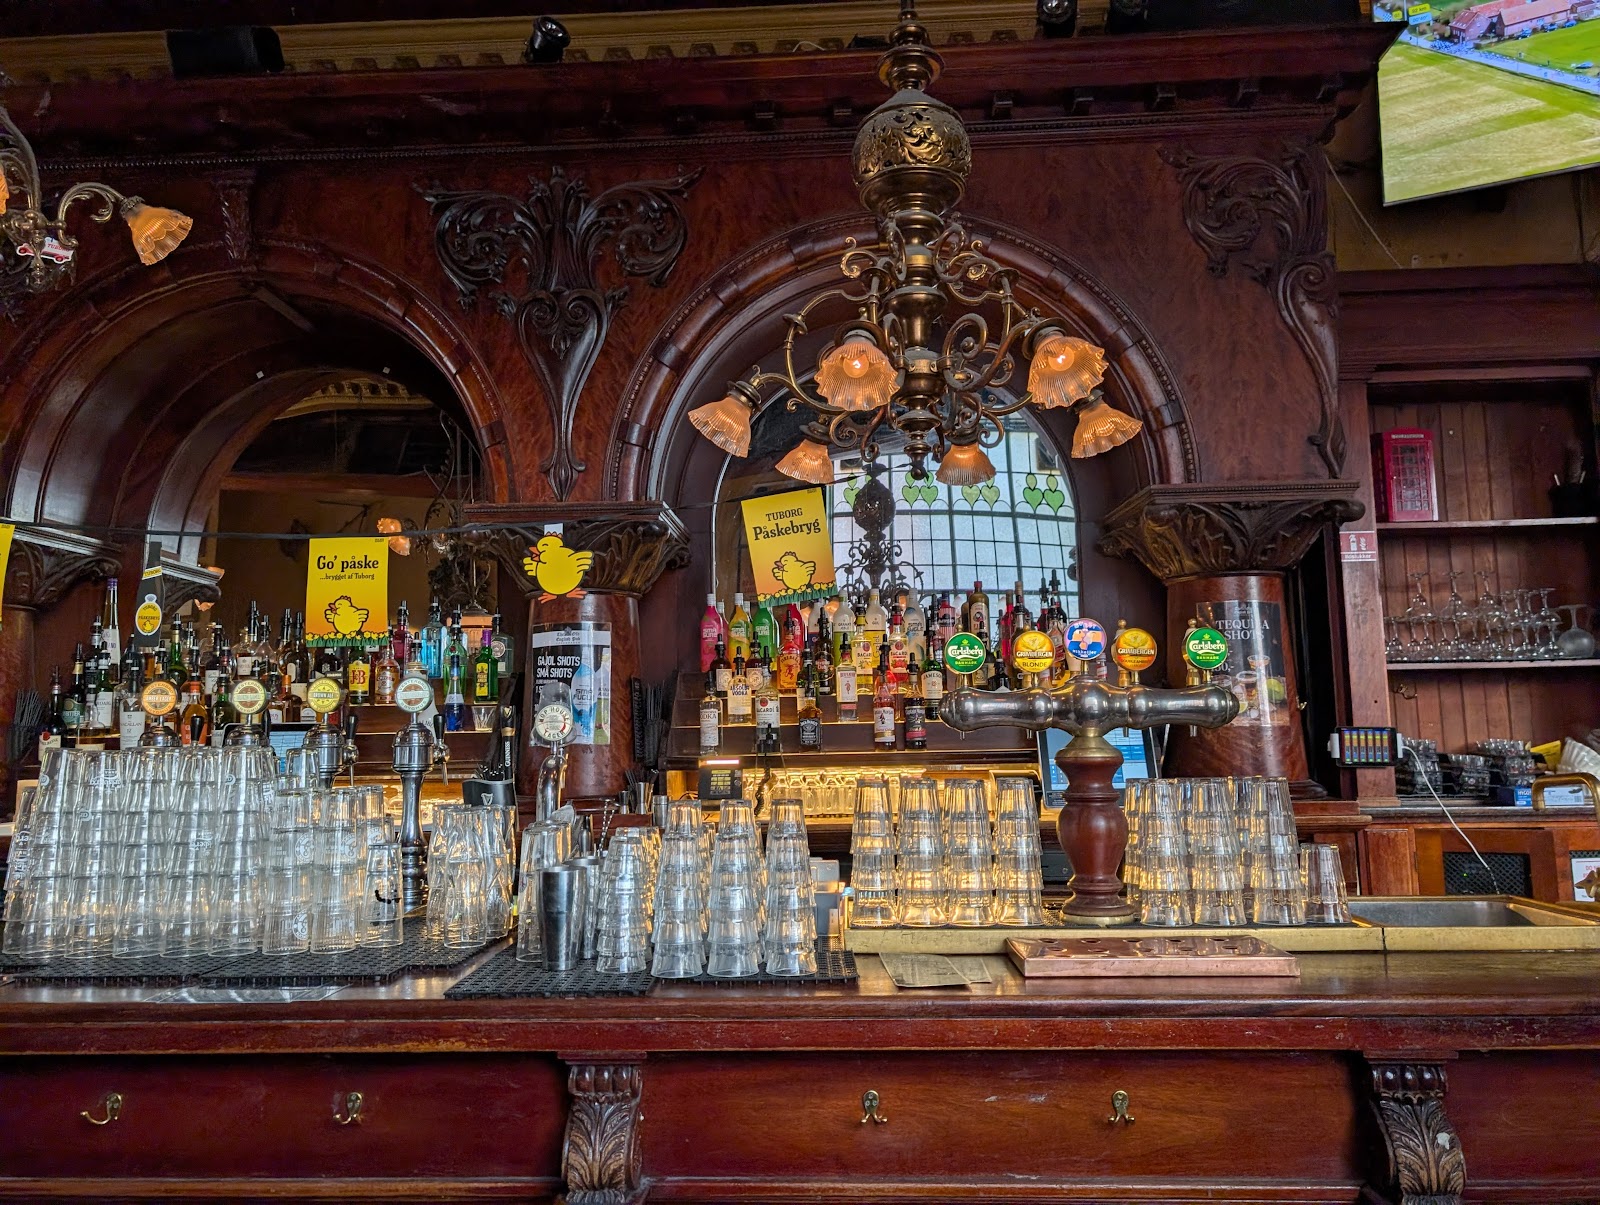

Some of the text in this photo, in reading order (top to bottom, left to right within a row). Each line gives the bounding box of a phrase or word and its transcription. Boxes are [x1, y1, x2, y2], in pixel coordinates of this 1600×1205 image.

[766, 507, 803, 521] TUBORG
[752, 518, 821, 541] Påskebryg
[341, 555, 379, 572] påske
[354, 572, 375, 580] Tuborg
[1224, 630, 1265, 640] SHOTS
[947, 645, 983, 659] Carlsberg
[1117, 647, 1155, 655] GRIMBERGEN
[1188, 640, 1225, 654] Carlsberg
[1016, 650, 1053, 658] GRIMBERGEN
[537, 655, 580, 667] GAJOL SHOTS
[550, 667, 573, 678] SHOTS
